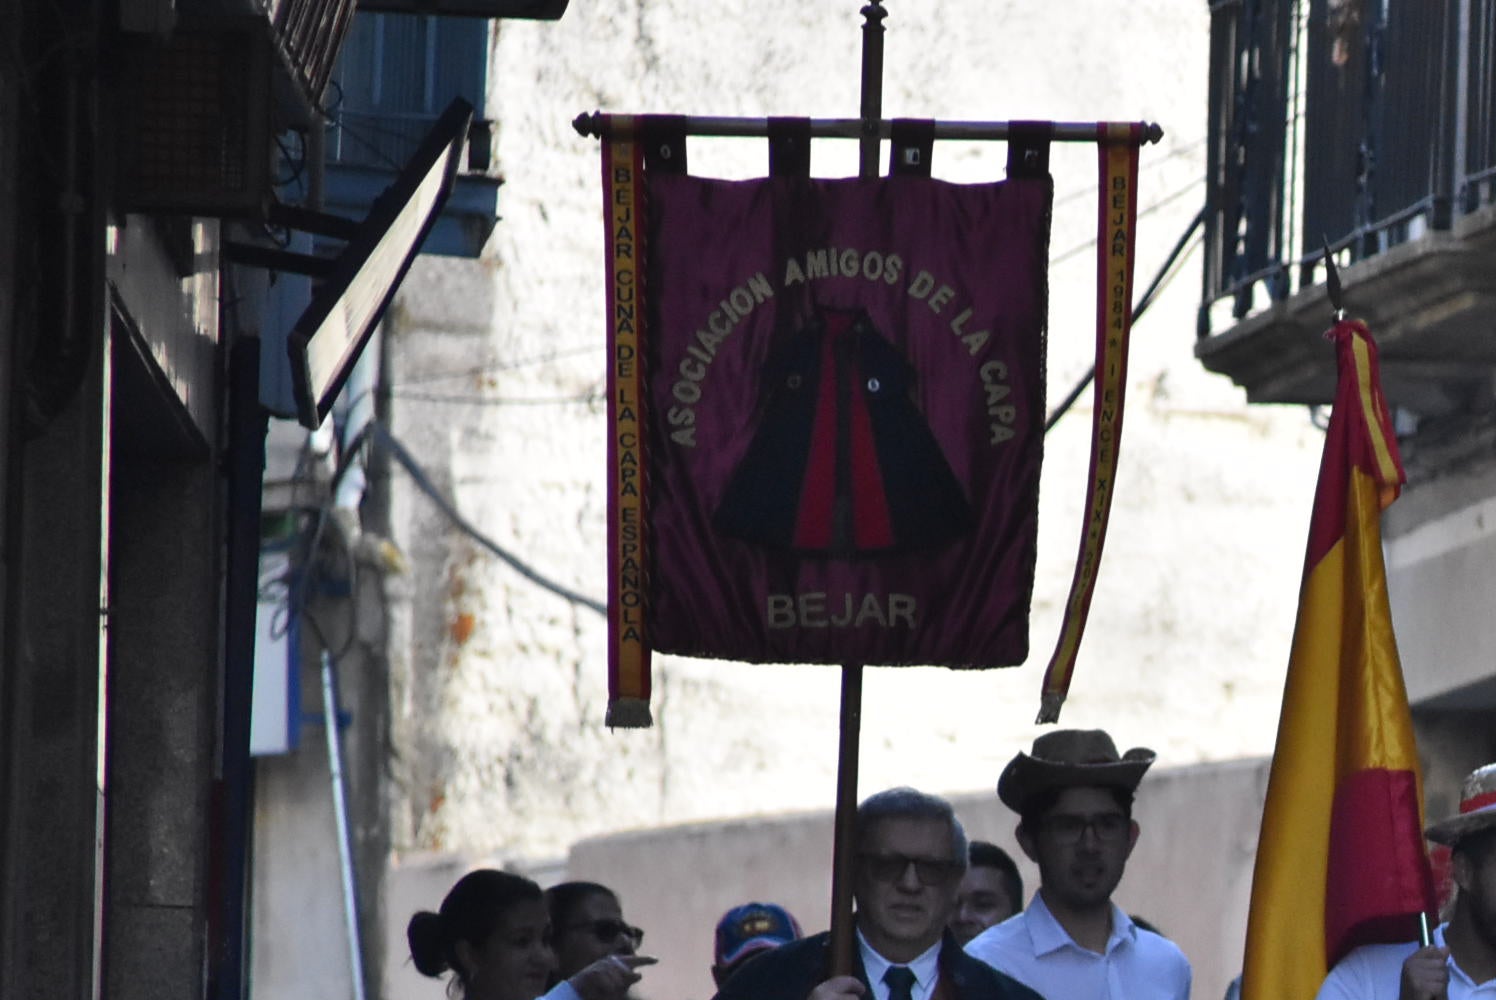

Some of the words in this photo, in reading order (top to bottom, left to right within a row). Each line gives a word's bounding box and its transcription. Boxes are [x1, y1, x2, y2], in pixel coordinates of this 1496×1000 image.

[614, 168, 633, 258] BEJAR
[1111, 176, 1126, 257] BEJAR
[615, 270, 634, 333] CUNA
[1111, 270, 1125, 329] 1984
[616, 345, 635, 378] DE
[667, 271, 774, 449] ASOCIACION
[784, 248, 902, 287] AMIGOS
[907, 270, 956, 315] DE
[950, 307, 991, 356] LA
[979, 360, 1016, 446] CAPA
[618, 389, 636, 422] LA
[618, 433, 638, 496] CAPA
[767, 592, 917, 629] BEJAR
